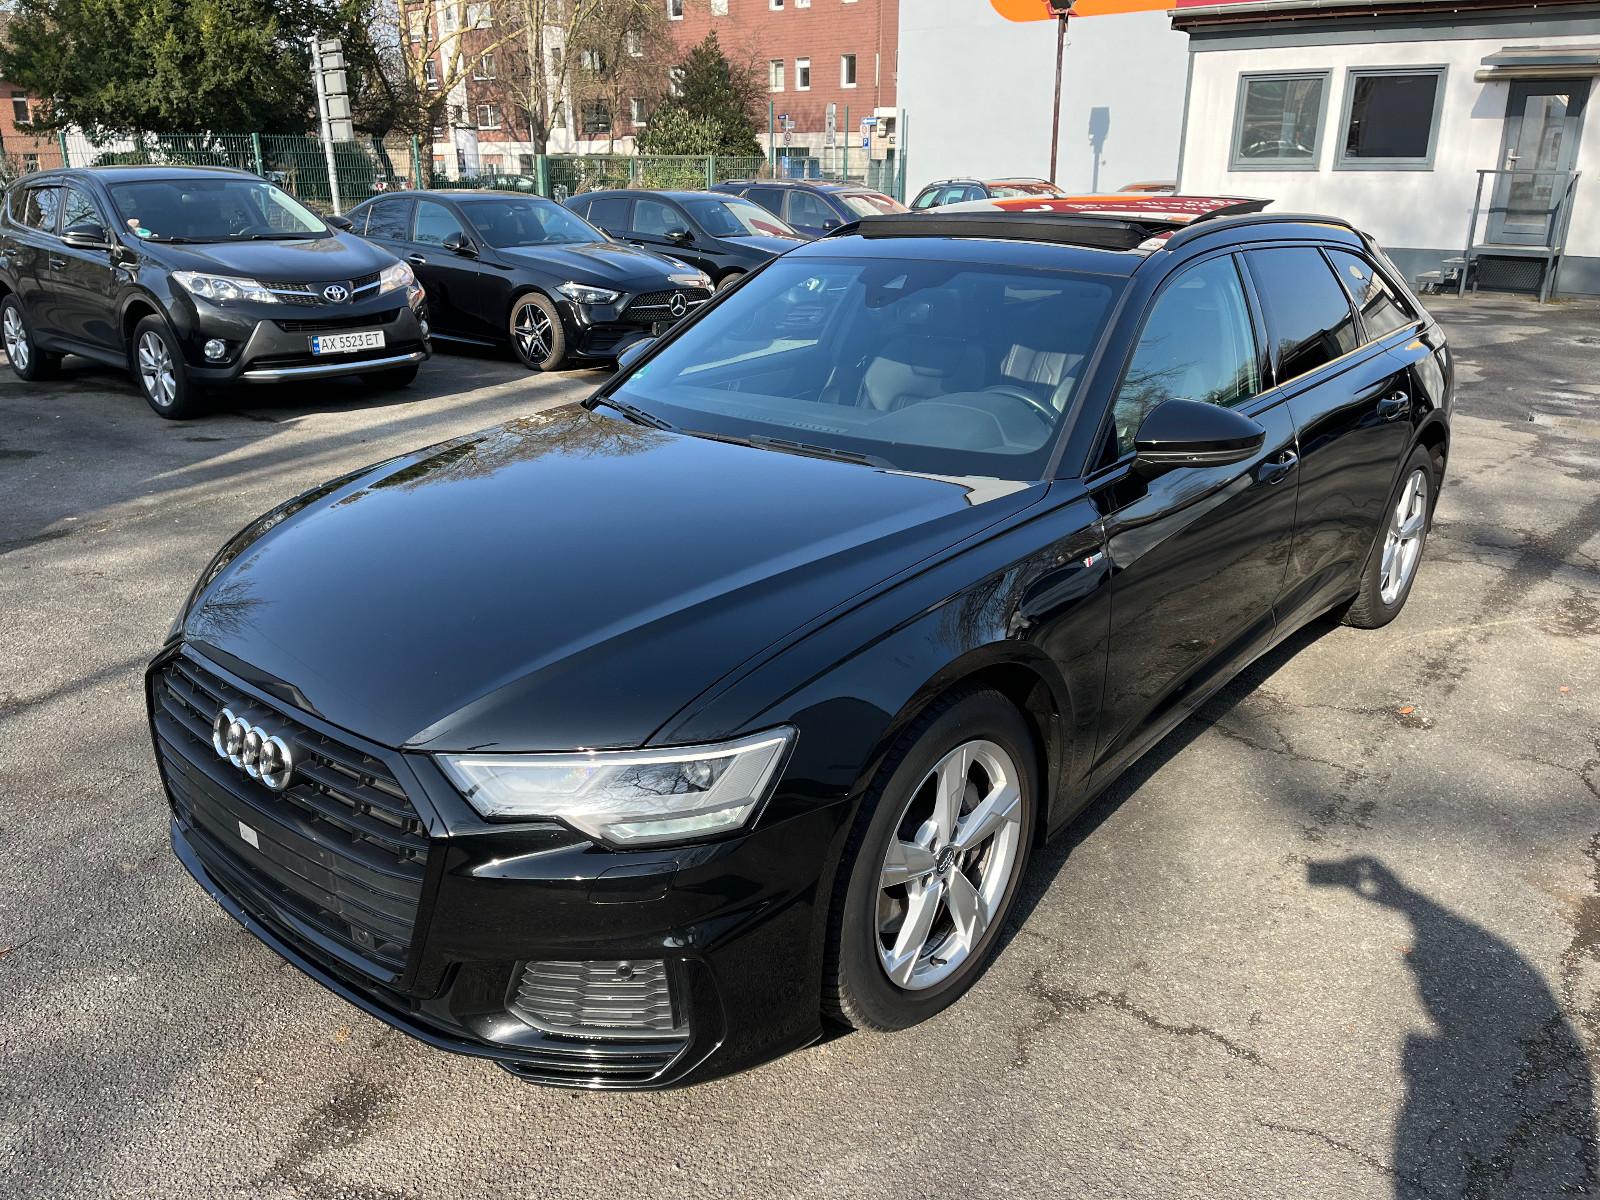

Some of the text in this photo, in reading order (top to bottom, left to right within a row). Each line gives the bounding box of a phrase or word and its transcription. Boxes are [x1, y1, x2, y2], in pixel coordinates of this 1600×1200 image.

[322, 333, 379, 350] AX 5523 ET
